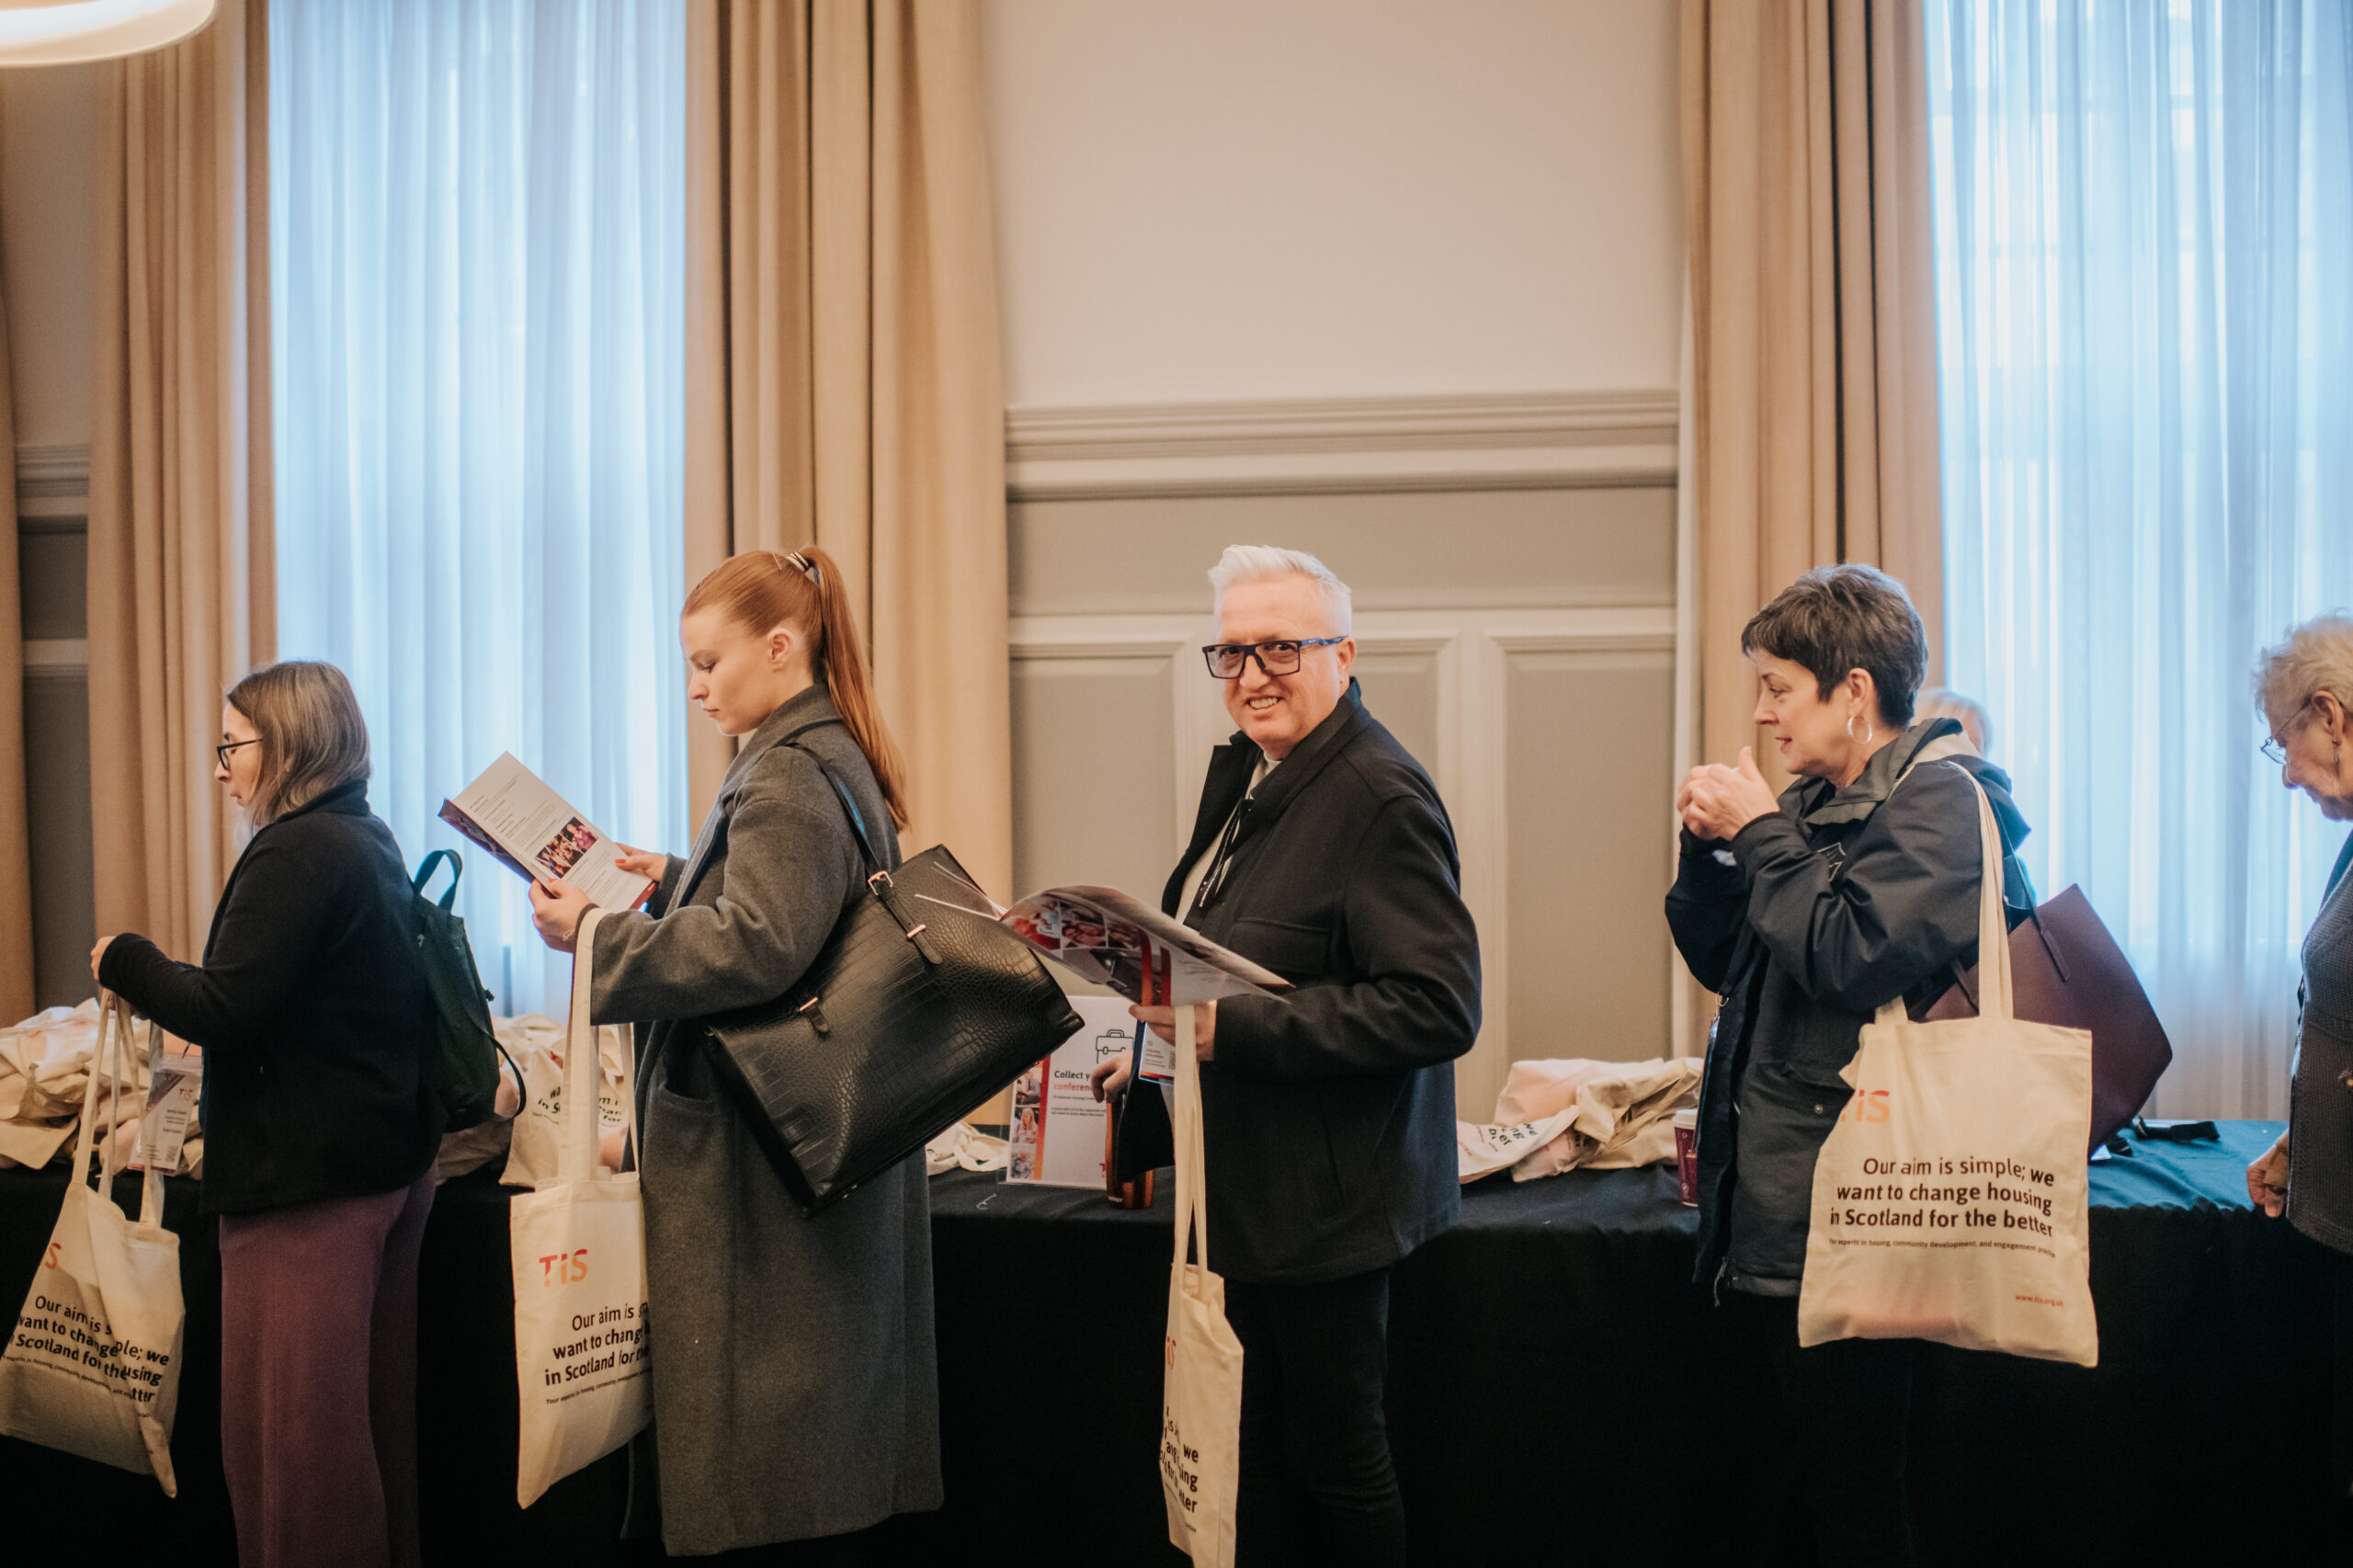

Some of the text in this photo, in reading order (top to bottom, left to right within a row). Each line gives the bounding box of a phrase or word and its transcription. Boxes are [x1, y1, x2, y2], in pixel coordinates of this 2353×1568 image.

[1053, 1083, 1094, 1092] conferen
[1054, 1070, 1084, 1080] Collect
[1863, 1155, 2054, 1187] Our aim is simple; we
[1837, 1181, 2052, 1217] want to change housing
[1830, 1207, 2052, 1237] in Scotland for the better
[1893, 1241, 1928, 1249] community
[35, 1295, 62, 1314] Our
[63, 1305, 88, 1325] aim
[89, 1316, 101, 1334] is
[146, 1349, 170, 1367] we
[572, 1314, 597, 1332] Our
[598, 1306, 621, 1324] aim
[624, 1302, 634, 1320] is
[52, 1320, 66, 1335] to
[70, 1328, 119, 1358] change
[552, 1337, 588, 1360] want
[590, 1335, 602, 1349] to
[16, 1333, 80, 1361] Scotland
[104, 1363, 128, 1381] the
[544, 1369, 562, 1387] in
[565, 1351, 615, 1381] Scotland
[1183, 1444, 1199, 1463] we
